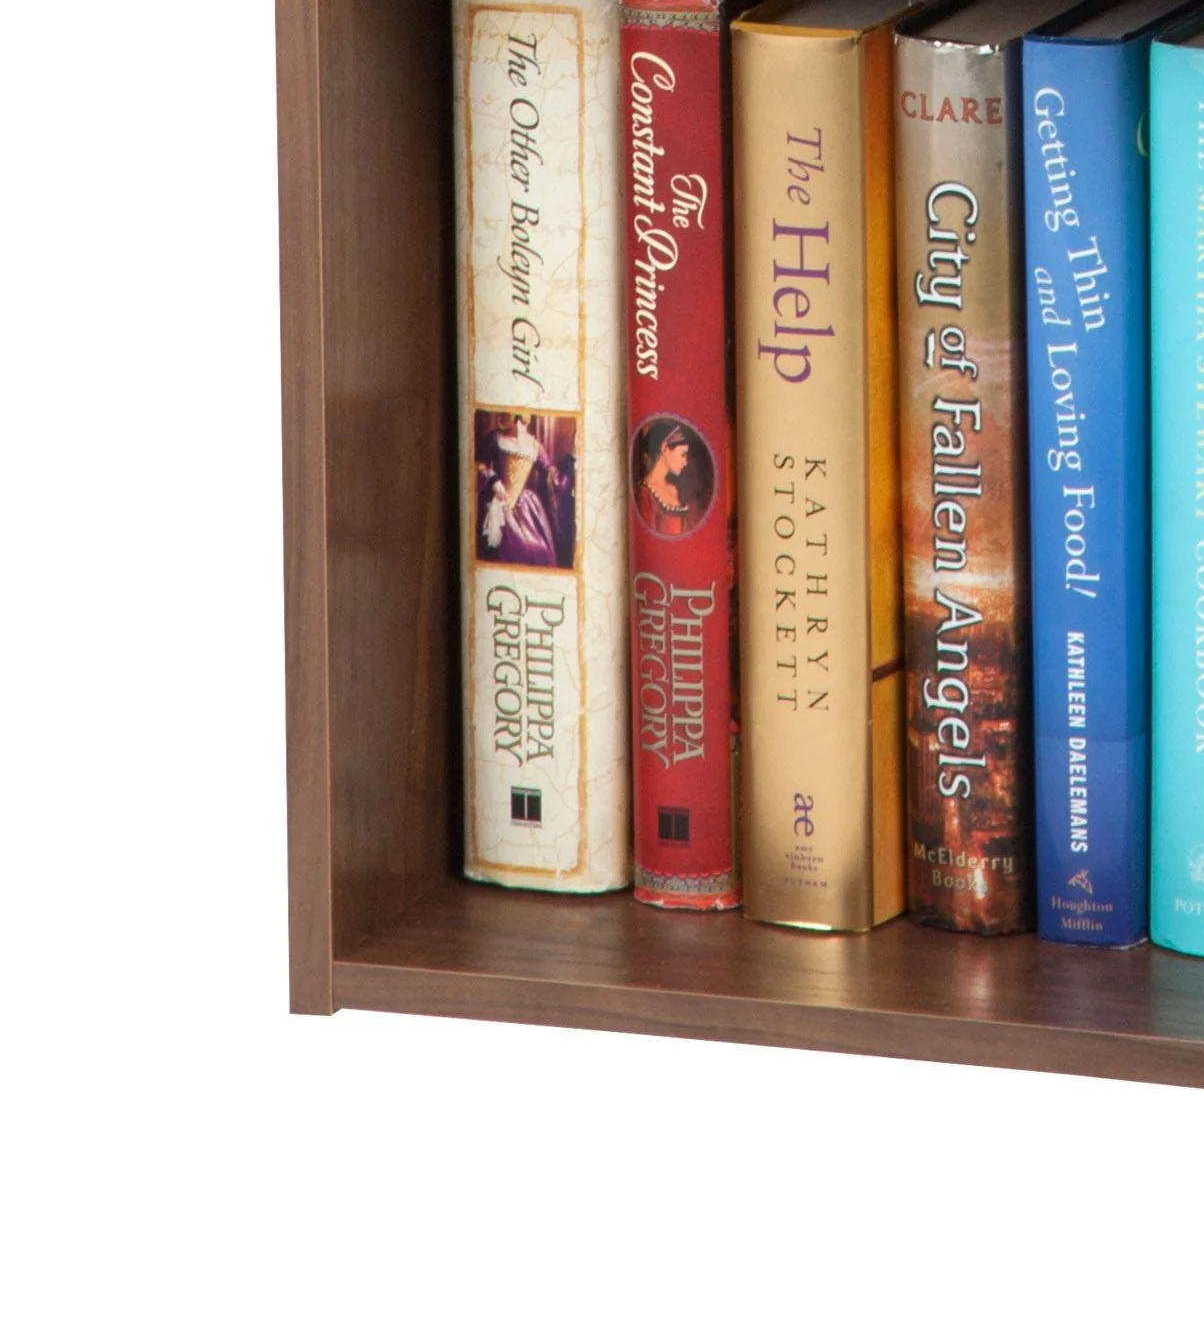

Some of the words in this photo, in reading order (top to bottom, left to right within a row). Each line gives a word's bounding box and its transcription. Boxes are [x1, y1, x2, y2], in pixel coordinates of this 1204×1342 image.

[508, 32, 541, 88] The
[901, 91, 1003, 125] CLARE
[509, 98, 544, 193] Other
[630, 51, 676, 215] Constant
[786, 127, 825, 206] The
[497, 199, 544, 306] Boleyn
[670, 173, 708, 230] The
[916, 181, 979, 310] City
[1034, 87, 1080, 233] Getting
[1068, 235, 1110, 332] Thin
[634, 213, 678, 380] Princess
[757, 218, 835, 384] Help
[940, 325, 979, 379] of
[1034, 267, 1071, 326] and
[511, 317, 545, 394] Girl
[1047, 342, 1086, 472] Loving
[931, 395, 983, 573] Fallen
[773, 453, 797, 711] STOCKETT
[804, 456, 830, 712] KATHRYN
[1063, 485, 1101, 599] Food!
[486, 584, 526, 768] GREGORY
[525, 596, 566, 763] PHILIPPA
[633, 571, 674, 770] GREGORY
[670, 581, 717, 765] PHILIPPA
[923, 588, 986, 800] Angels
[1067, 631, 1086, 728] KATHLEEN
[1068, 738, 1088, 853] DAELEMANS
[913, 843, 1014, 875] McElderry
[932, 869, 988, 893] Books
[1051, 896, 1114, 915] Houghton
[1060, 917, 1104, 932] Mifflin
